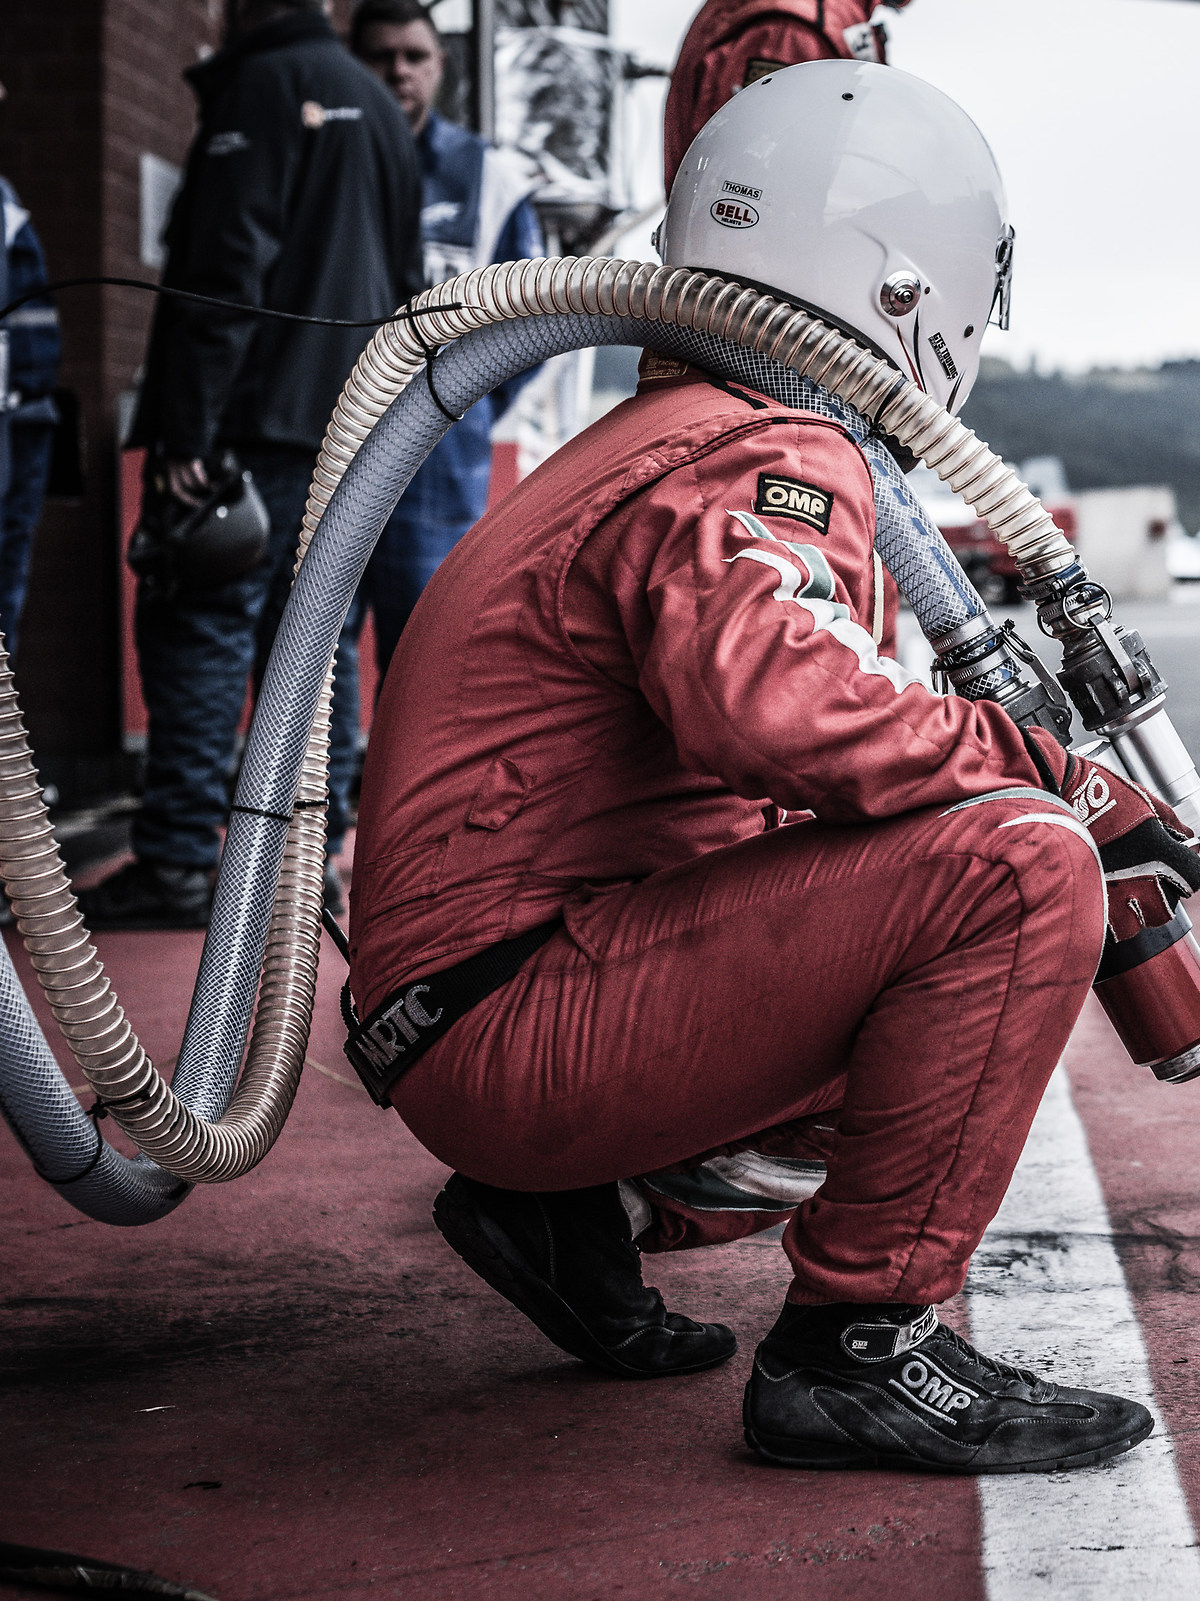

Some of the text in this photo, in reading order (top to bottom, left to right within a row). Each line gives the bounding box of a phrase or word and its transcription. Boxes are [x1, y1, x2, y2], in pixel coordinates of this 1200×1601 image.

[724, 182, 760, 198] THOMAS
[941, 346, 958, 380] TOURING
[765, 486, 826, 516] OMP
[901, 1360, 971, 1413] OMP
